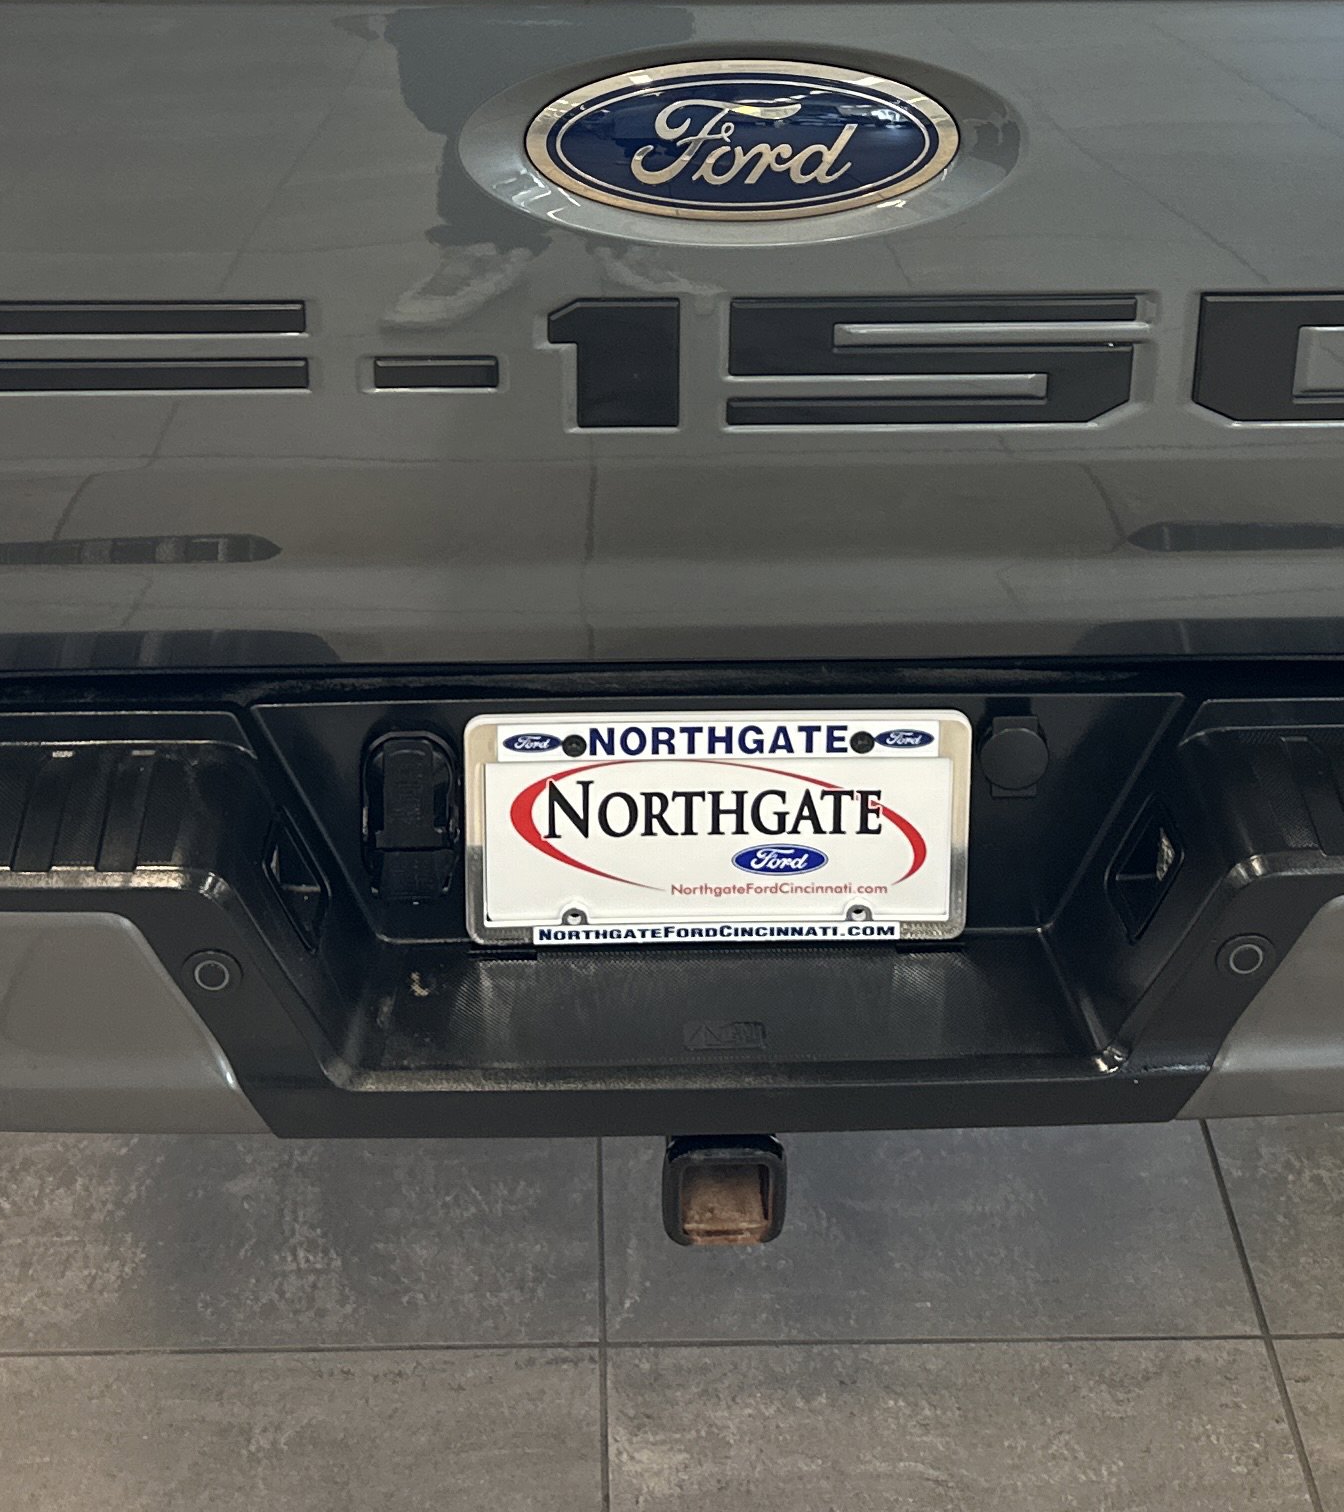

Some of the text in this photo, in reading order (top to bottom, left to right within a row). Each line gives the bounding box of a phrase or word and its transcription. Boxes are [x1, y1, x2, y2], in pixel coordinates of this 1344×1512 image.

[630, 98, 859, 187] Ford
[513, 724, 923, 756] Ford NORTHGATE Ford
[542, 779, 883, 839] NORTHGATE
[750, 848, 810, 870] Ford
[670, 882, 888, 897] NorthgateFordCincinnati.com
